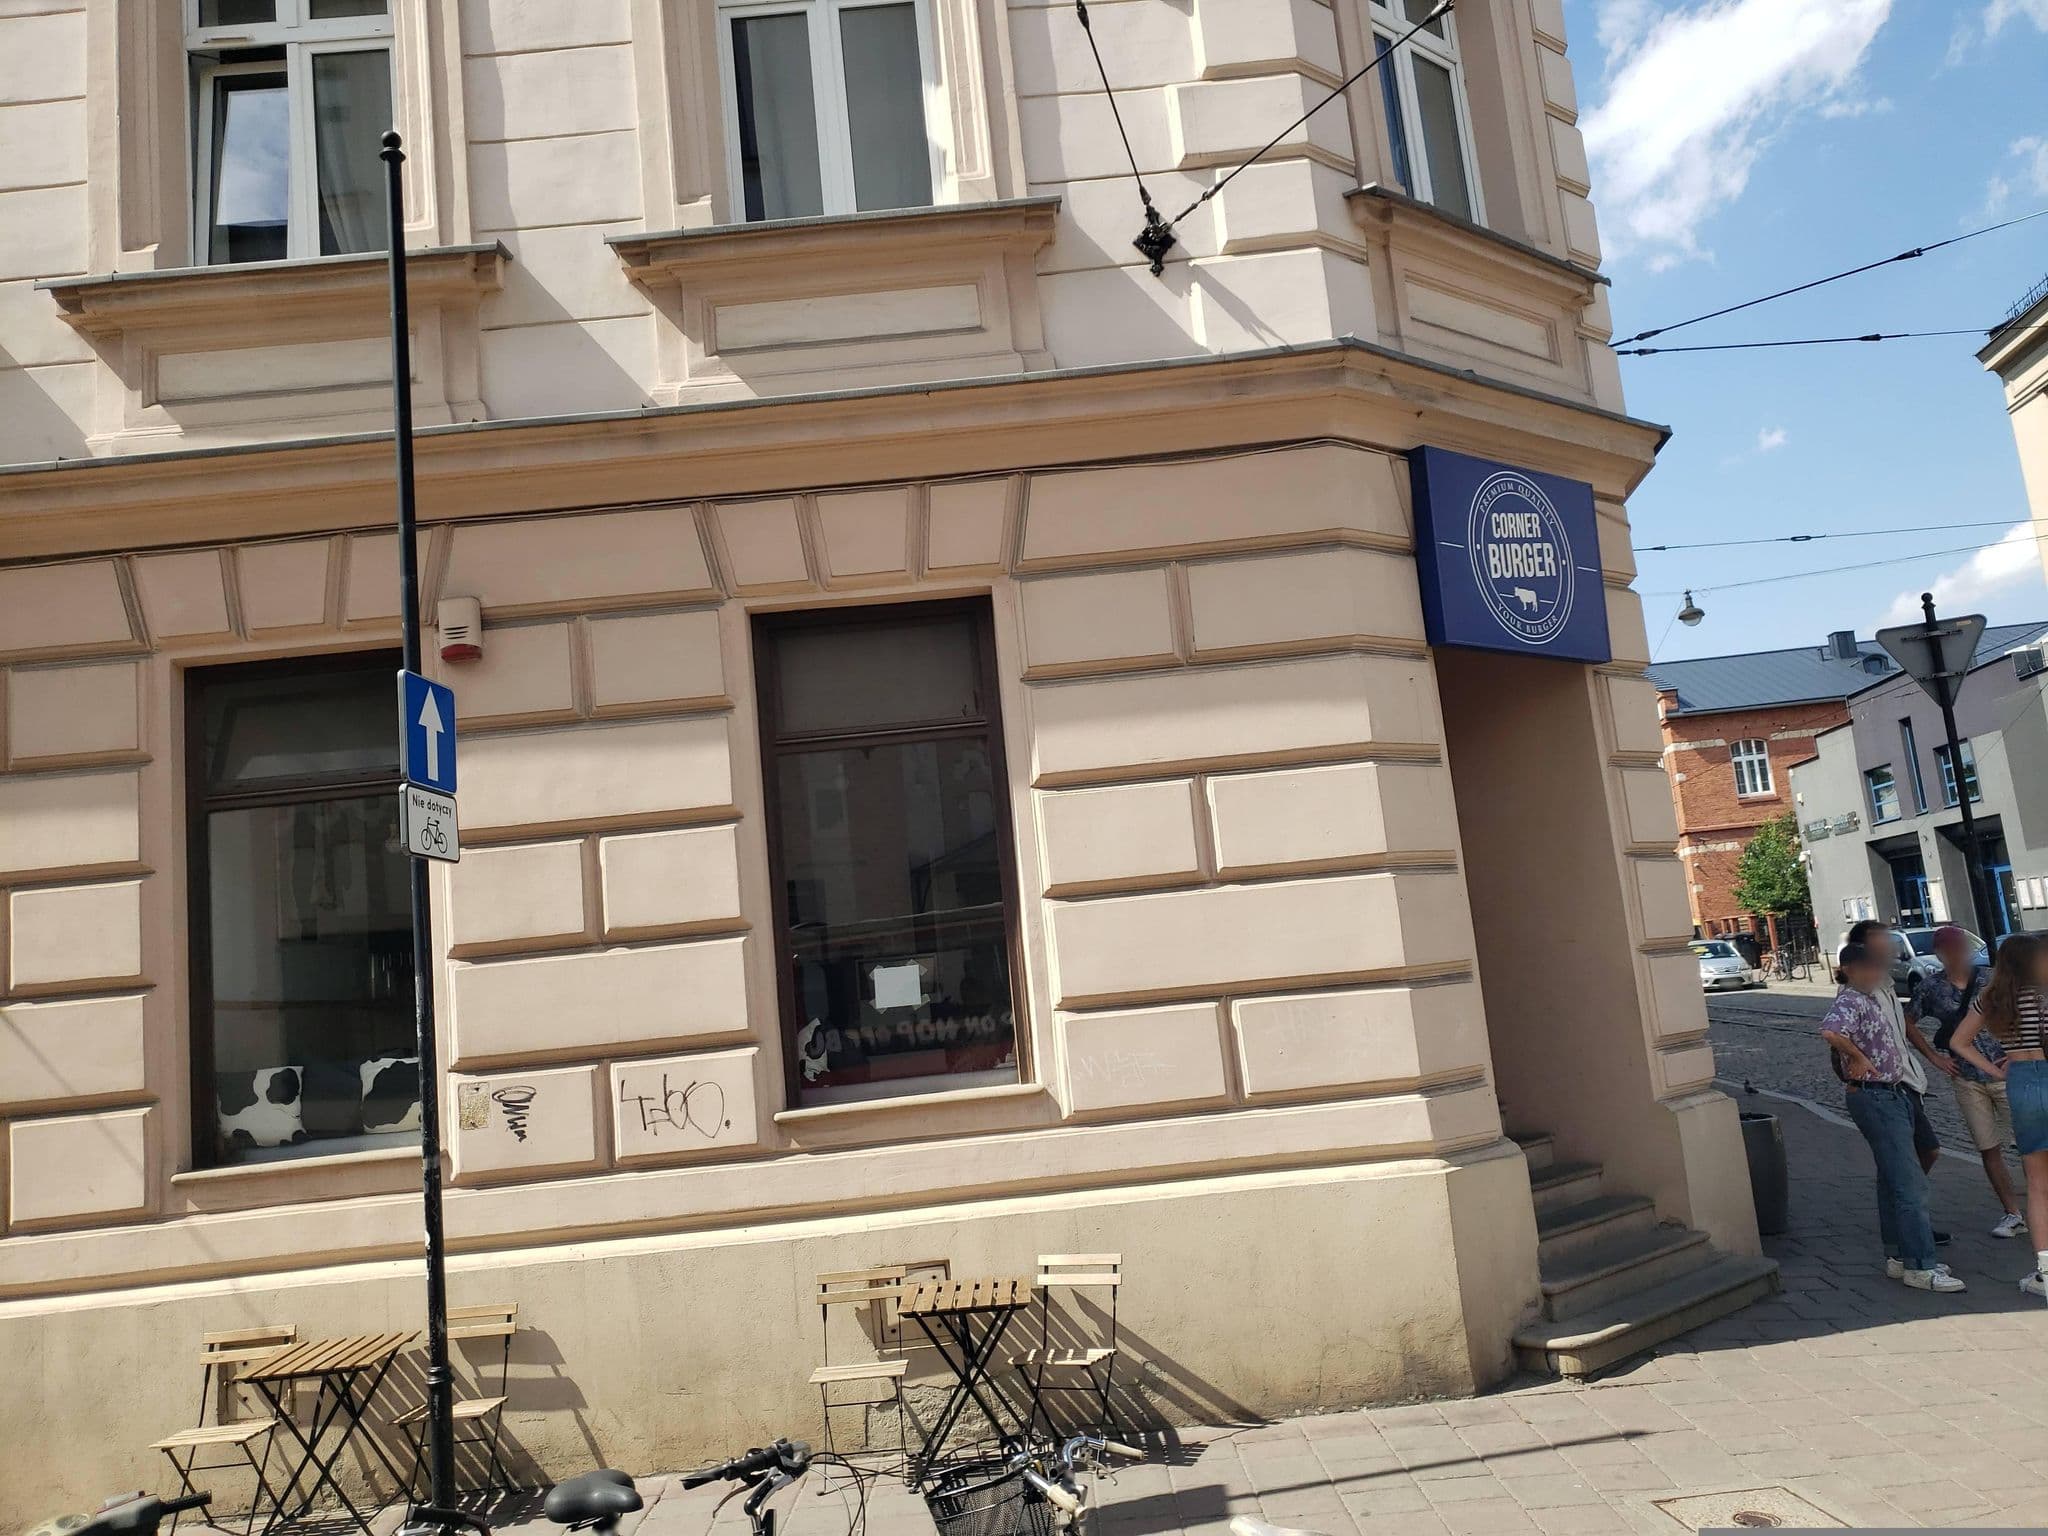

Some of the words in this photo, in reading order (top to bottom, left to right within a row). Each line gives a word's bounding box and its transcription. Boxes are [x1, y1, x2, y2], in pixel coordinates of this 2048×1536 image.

[1479, 482, 1514, 513] PREMIUM
[1518, 484, 1556, 525] QUALITY
[1491, 512, 1542, 539] CORNER
[1488, 542, 1557, 579] BURGER
[1498, 603, 1522, 630] YOUR
[1526, 614, 1558, 634] BURGER
[412, 793, 424, 808] Nie
[427, 798, 452, 818] dotyczy
